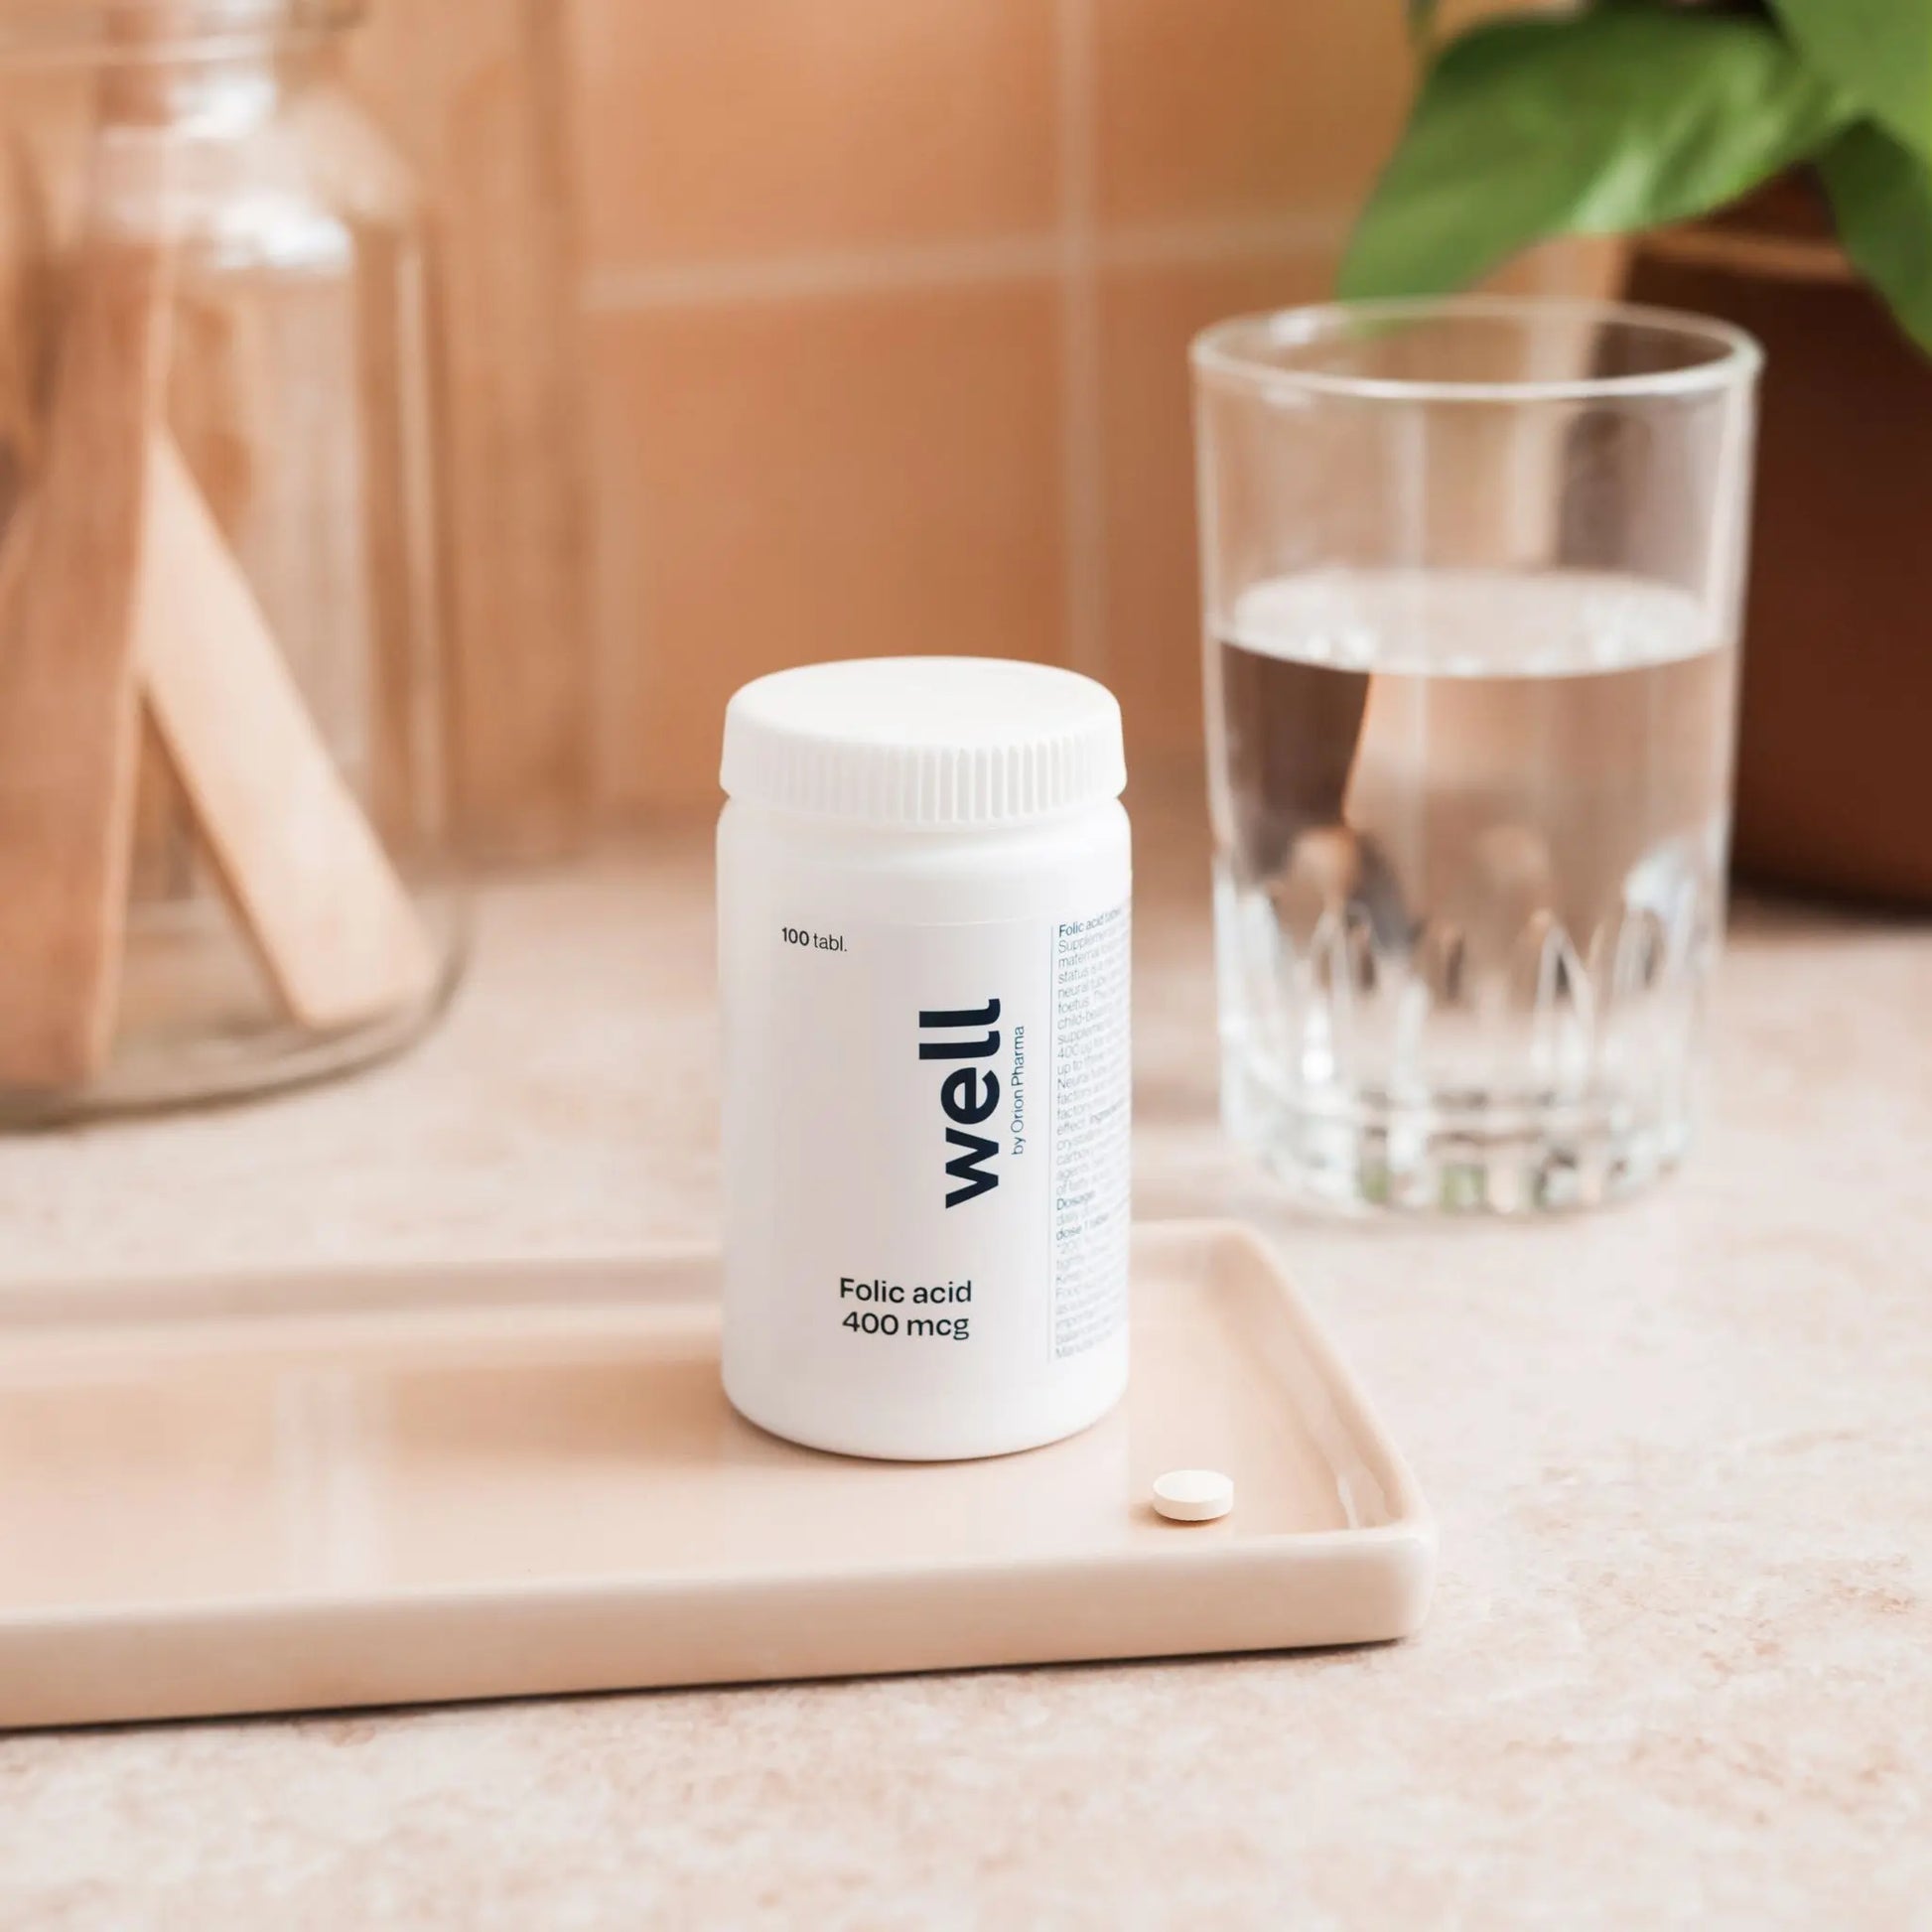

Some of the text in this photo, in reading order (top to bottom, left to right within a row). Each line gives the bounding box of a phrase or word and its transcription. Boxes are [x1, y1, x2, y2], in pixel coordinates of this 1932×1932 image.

[782, 927, 848, 952] 100 tabl.
[1058, 921, 1085, 938] Folic
[918, 998, 1001, 1209] well
[1010, 1026, 1027, 1156] by Orion Pharma
[840, 1277, 972, 1305] Folic acid
[842, 1311, 970, 1341] 400 mcg
